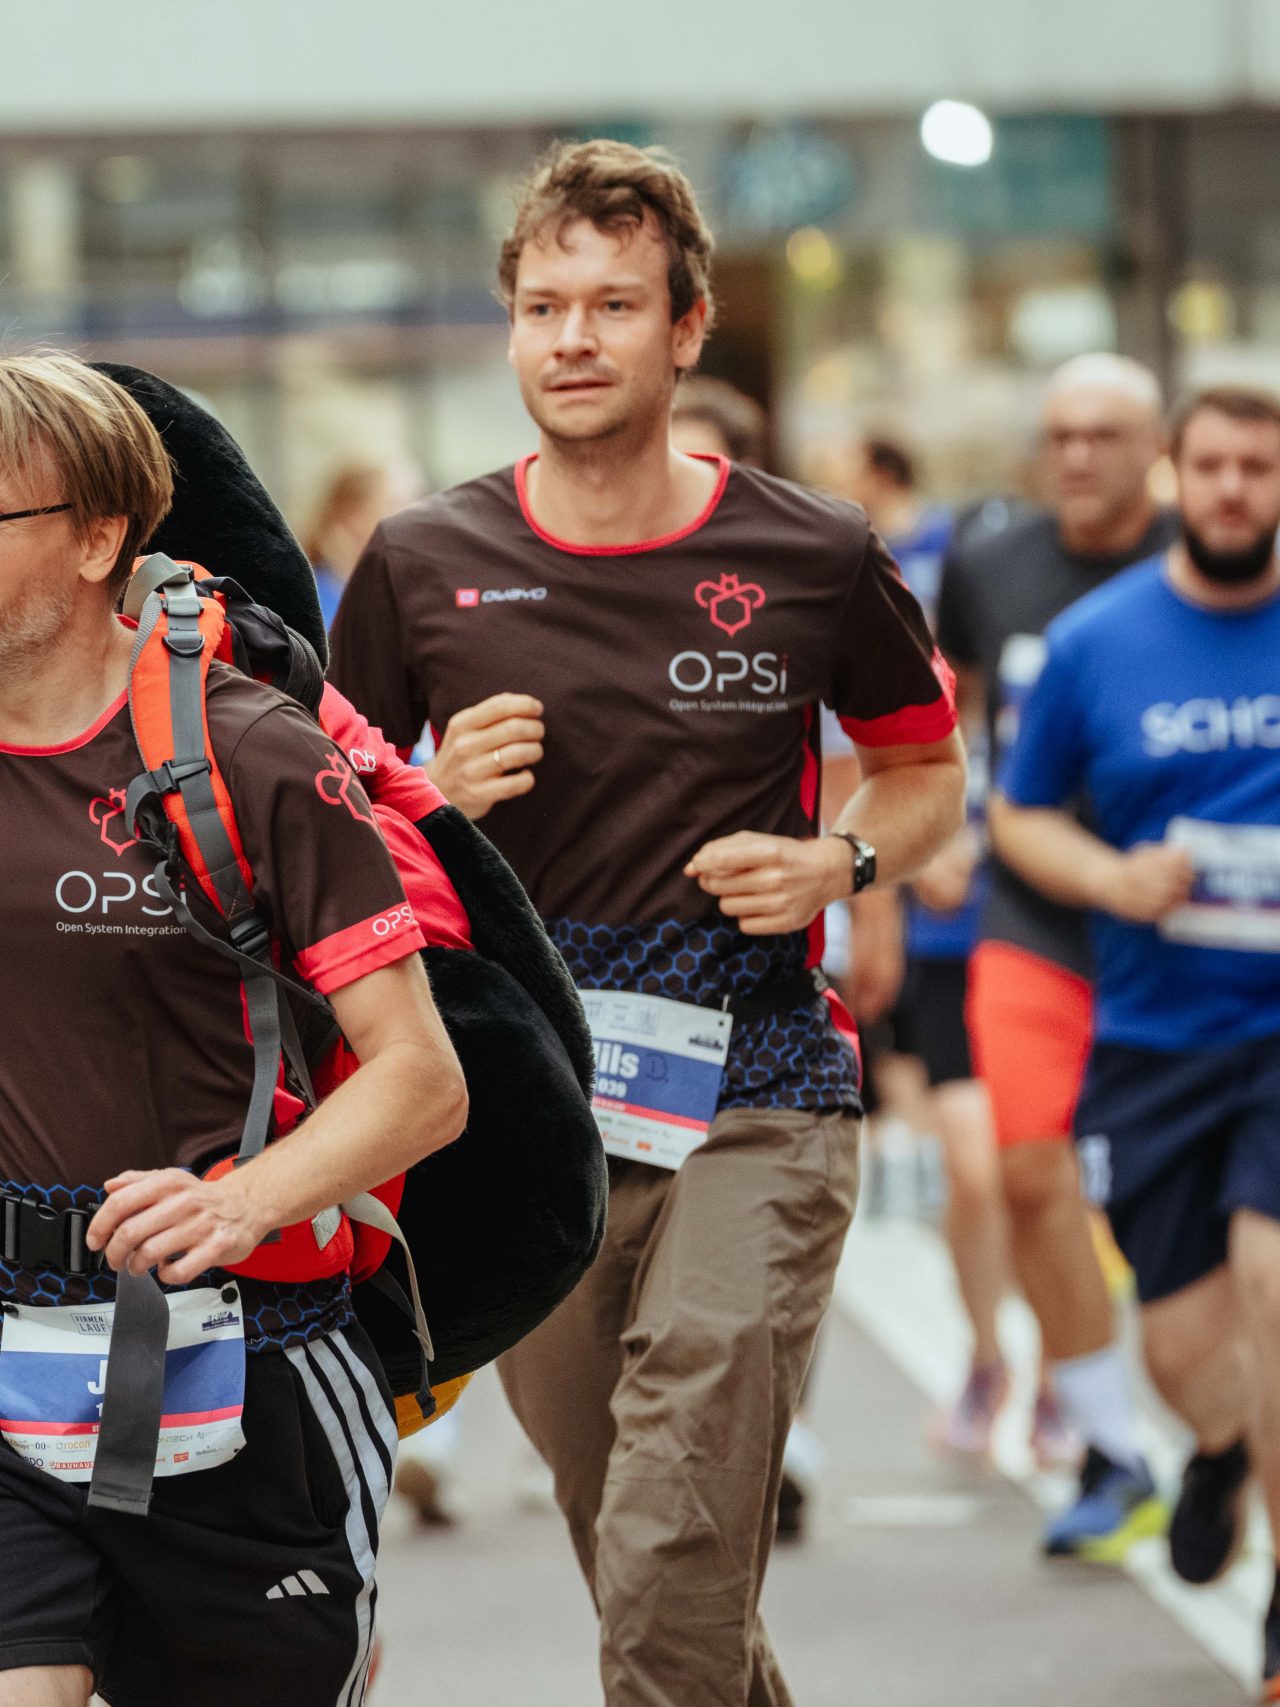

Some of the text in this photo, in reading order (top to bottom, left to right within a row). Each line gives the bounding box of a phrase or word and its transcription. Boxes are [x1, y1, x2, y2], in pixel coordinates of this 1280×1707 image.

[56, 921, 187, 937] Open System Integration
[75, 1315, 104, 1323] FIRMEN
